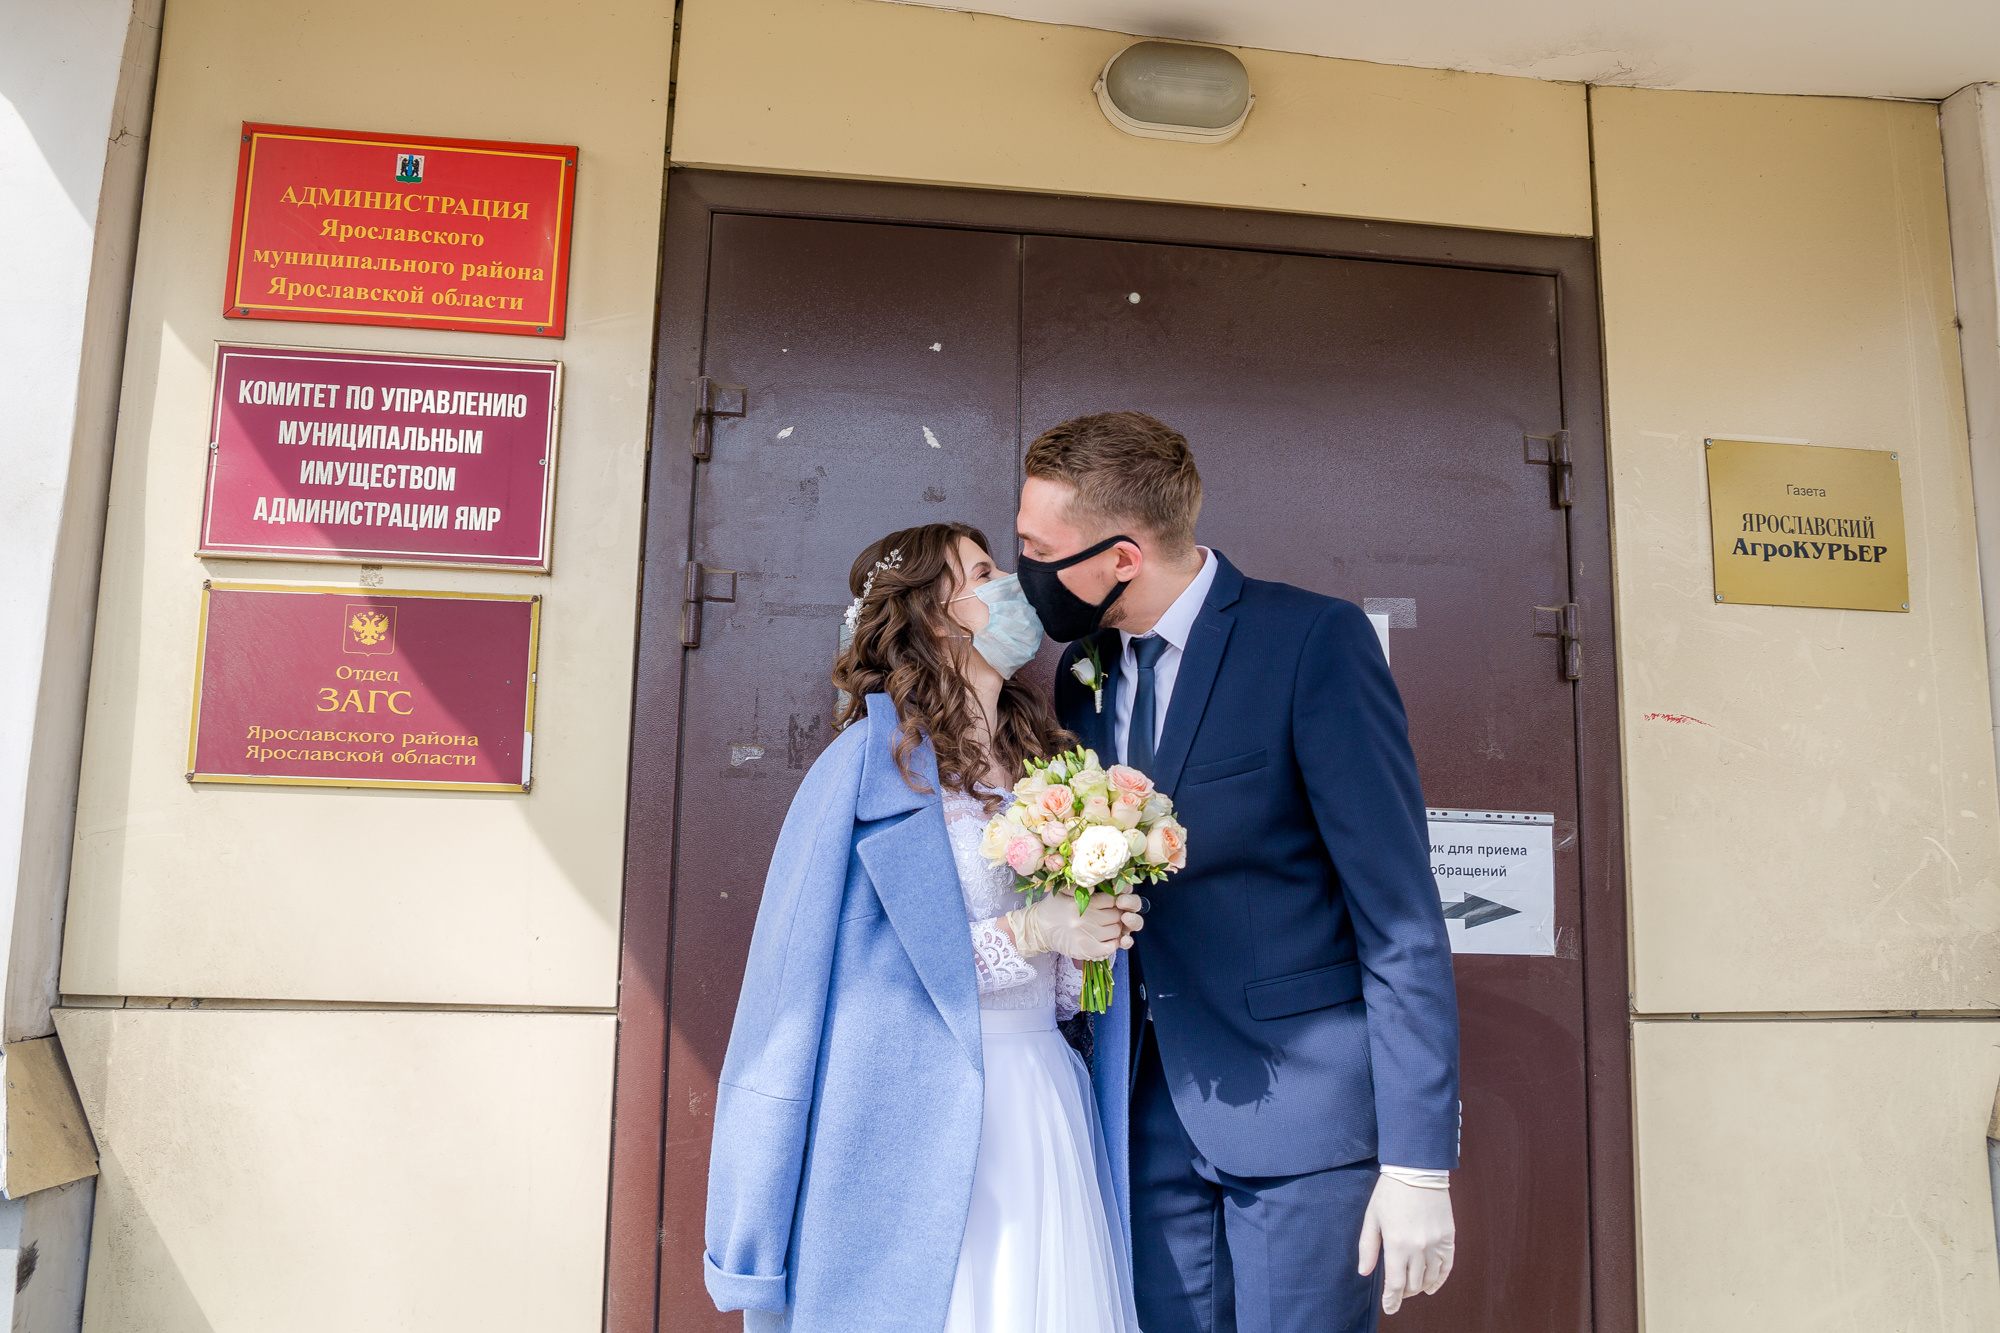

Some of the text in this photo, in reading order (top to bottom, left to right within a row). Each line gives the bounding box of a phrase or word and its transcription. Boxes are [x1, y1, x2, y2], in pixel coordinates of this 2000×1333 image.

[279, 185, 530, 221] АДМИНИСТРАЦИЯ
[319, 218, 485, 247] Ярославского
[252, 249, 545, 282] муниципального района
[267, 276, 524, 310] Ярославской области
[238, 379, 528, 418] КОМИТЕТ ПО УПРАВЛЕНИЮ
[278, 420, 484, 455] МУНИЦИПАЛЬНЫМ
[299, 459, 456, 492] ИМУЩЕСТВОМ
[1786, 484, 1826, 498] Газета
[253, 496, 501, 532] АДМИНИСТРАЦИИ ЯМР
[1742, 512, 1876, 540] ЯРОСЛАВСКИЙ
[1732, 537, 1888, 563] АгроКУРЬЕР
[335, 665, 399, 682] Отдел
[316, 687, 414, 716] ЗАГС
[246, 725, 479, 750] Ярославского района
[245, 745, 477, 767] Ярославской области
[1430, 844, 1528, 857] ик для приема
[1430, 863, 1507, 878] обращений
